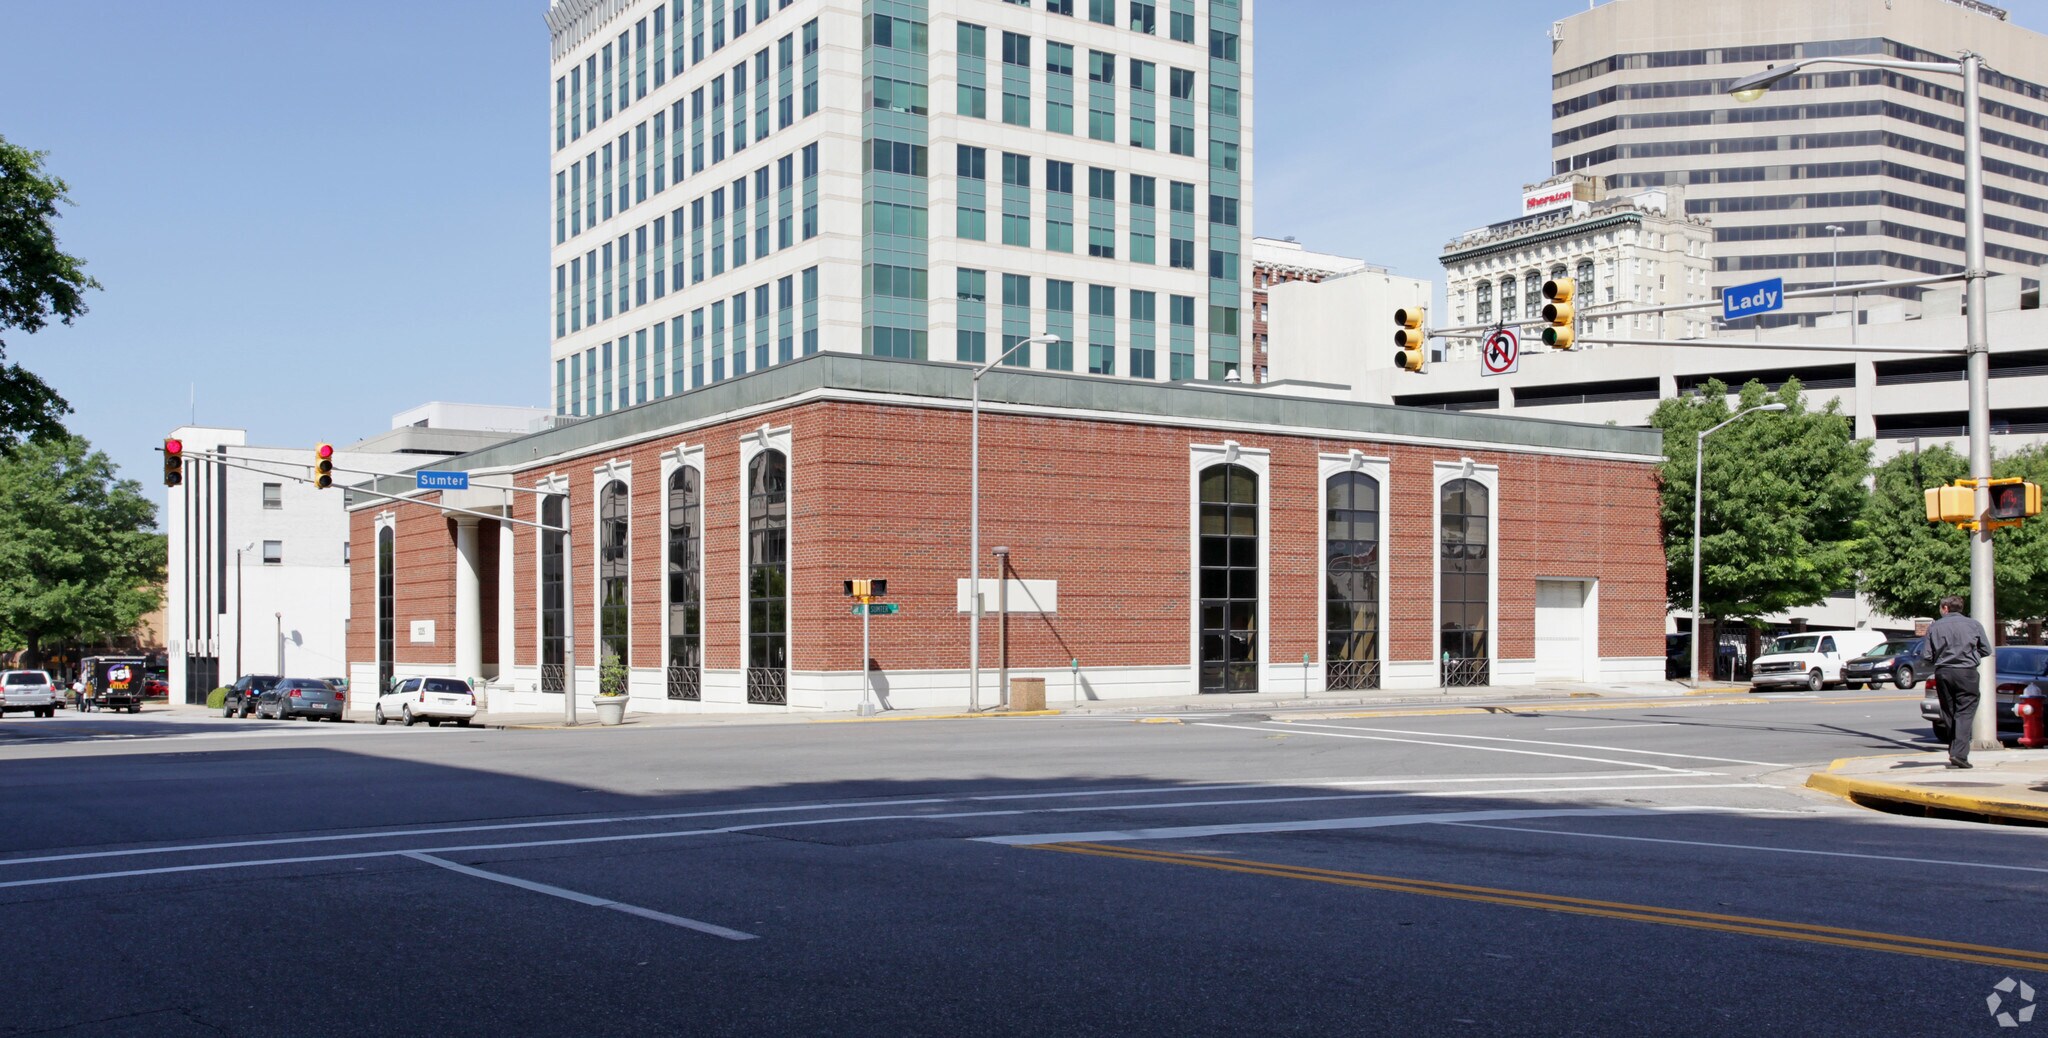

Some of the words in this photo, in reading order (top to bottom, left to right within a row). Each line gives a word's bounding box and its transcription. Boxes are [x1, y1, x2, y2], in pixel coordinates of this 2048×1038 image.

[1527, 191, 1571, 208] Sheraton
[1727, 288, 1778, 312] Lady
[421, 474, 465, 486] Sumter
[870, 605, 889, 613] SUMTER
[109, 681, 129, 690] office
